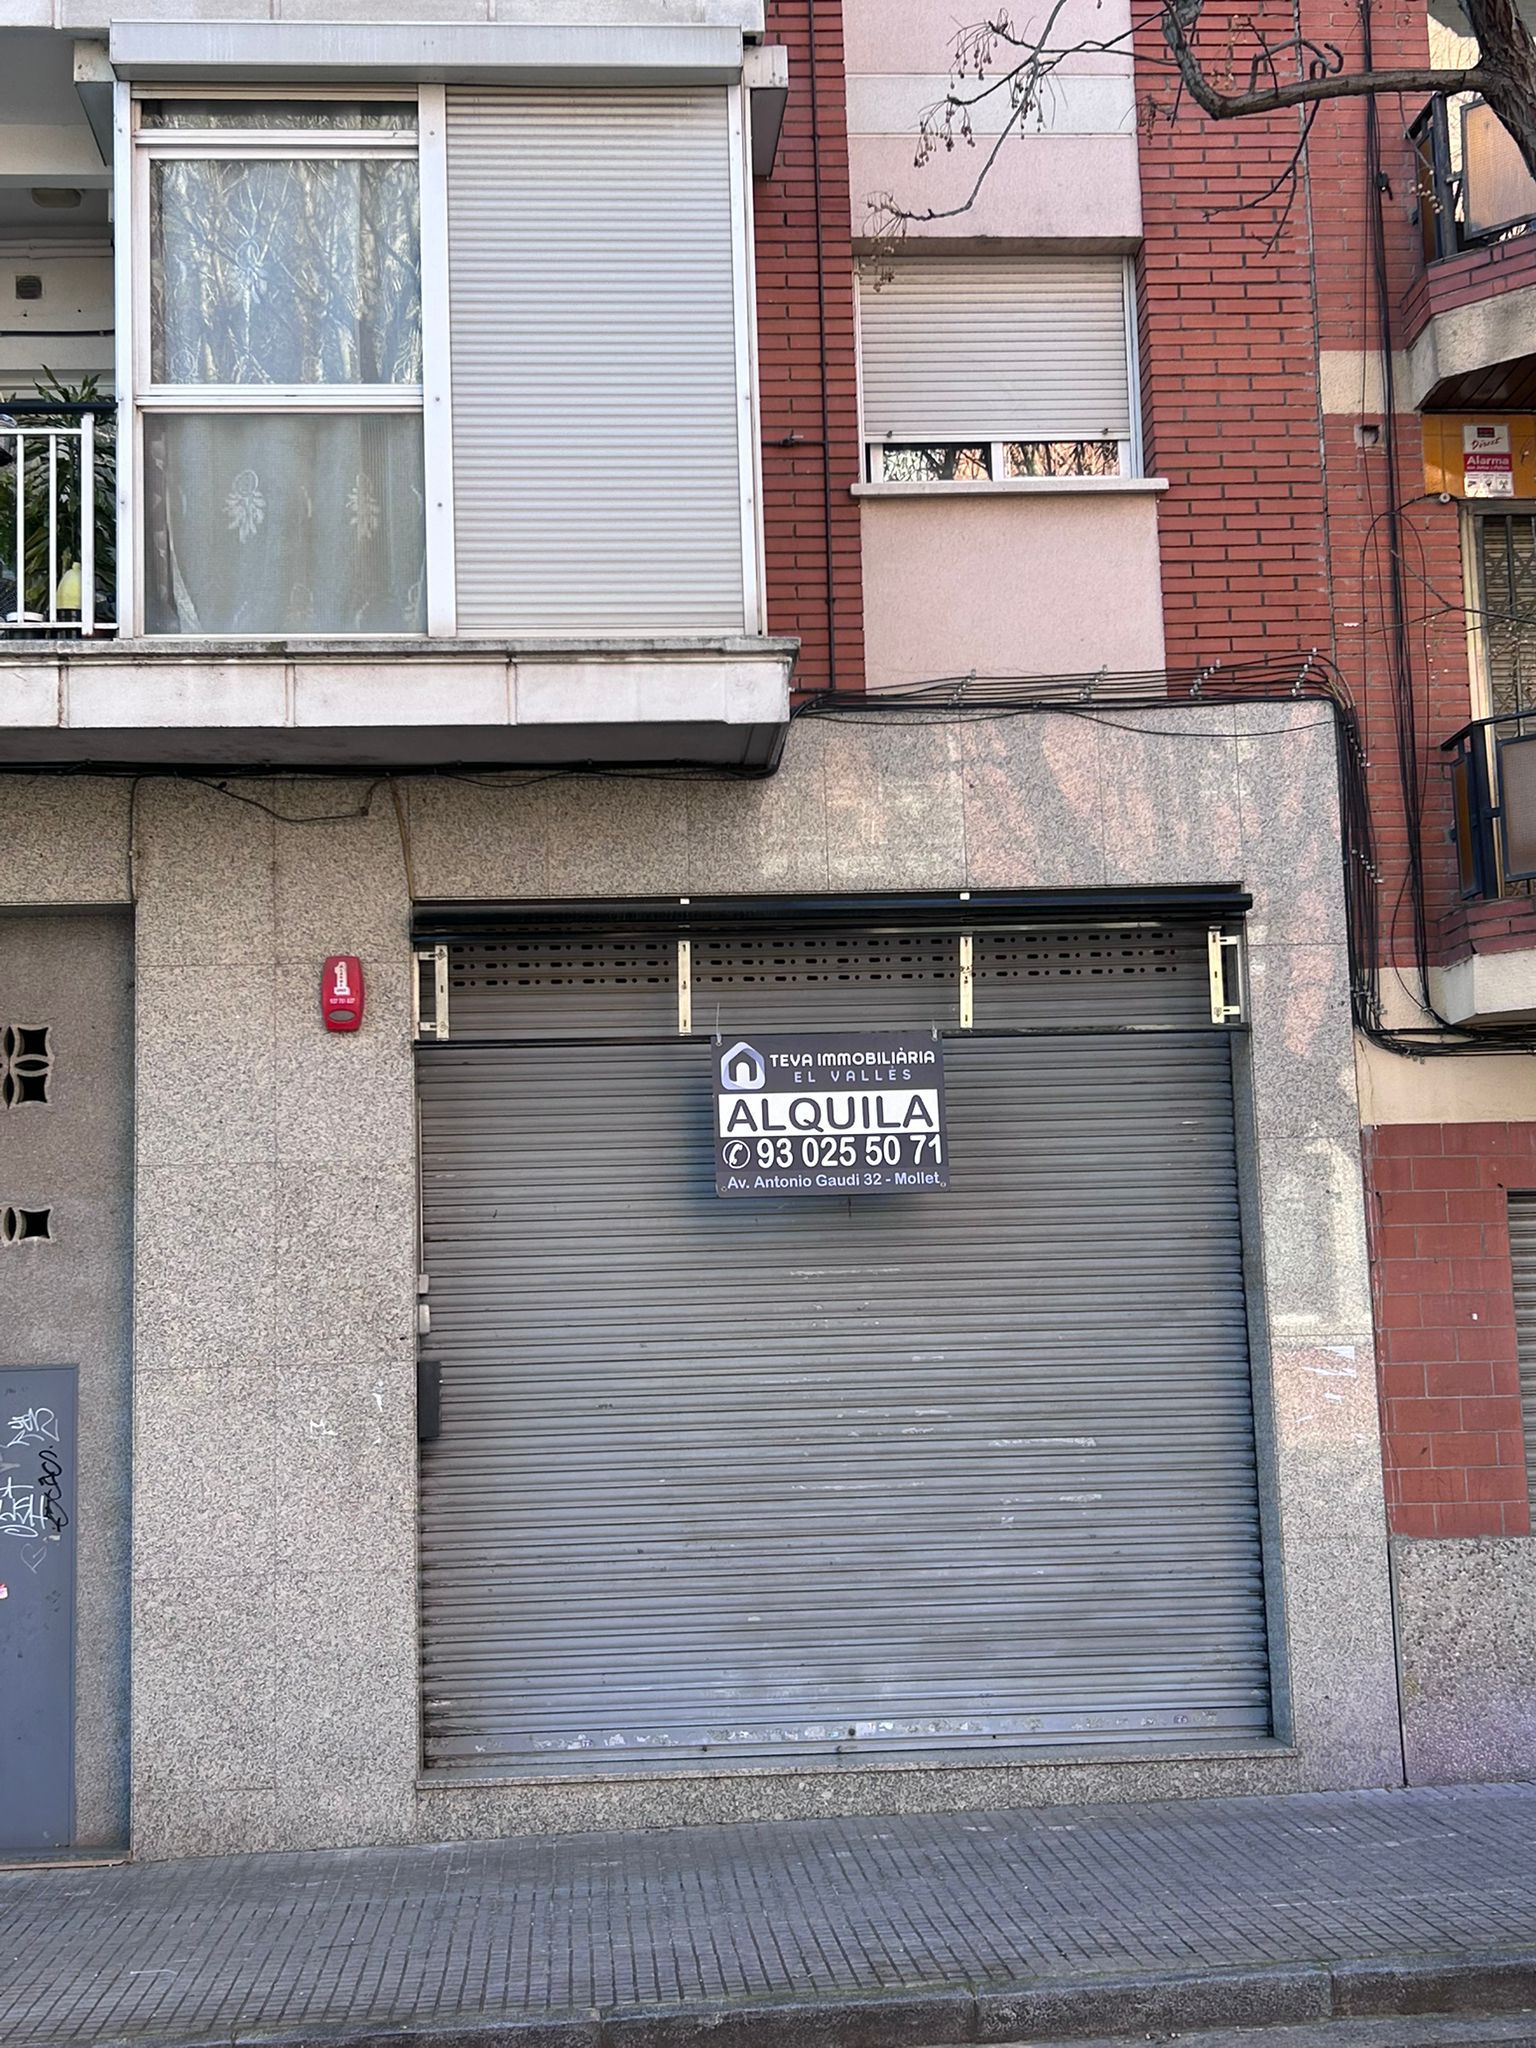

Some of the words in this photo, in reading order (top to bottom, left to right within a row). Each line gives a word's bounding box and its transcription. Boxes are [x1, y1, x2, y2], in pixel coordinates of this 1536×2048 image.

[1467, 455, 1509, 465] Alarma
[769, 1053, 813, 1067] TEVA
[794, 1071, 816, 1083] EL
[727, 1094, 934, 1133] ALQUILA
[756, 1138, 793, 1169] 93
[801, 1136, 857, 1167] 025
[865, 1135, 901, 1166] 50
[909, 1133, 942, 1165] 71
[727, 1176, 750, 1189] Av.
[754, 1175, 812, 1189] Antonio
[815, 1173, 860, 1187] Gaudi
[863, 1173, 882, 1186] 32
[894, 1171, 940, 1185] Mollet
